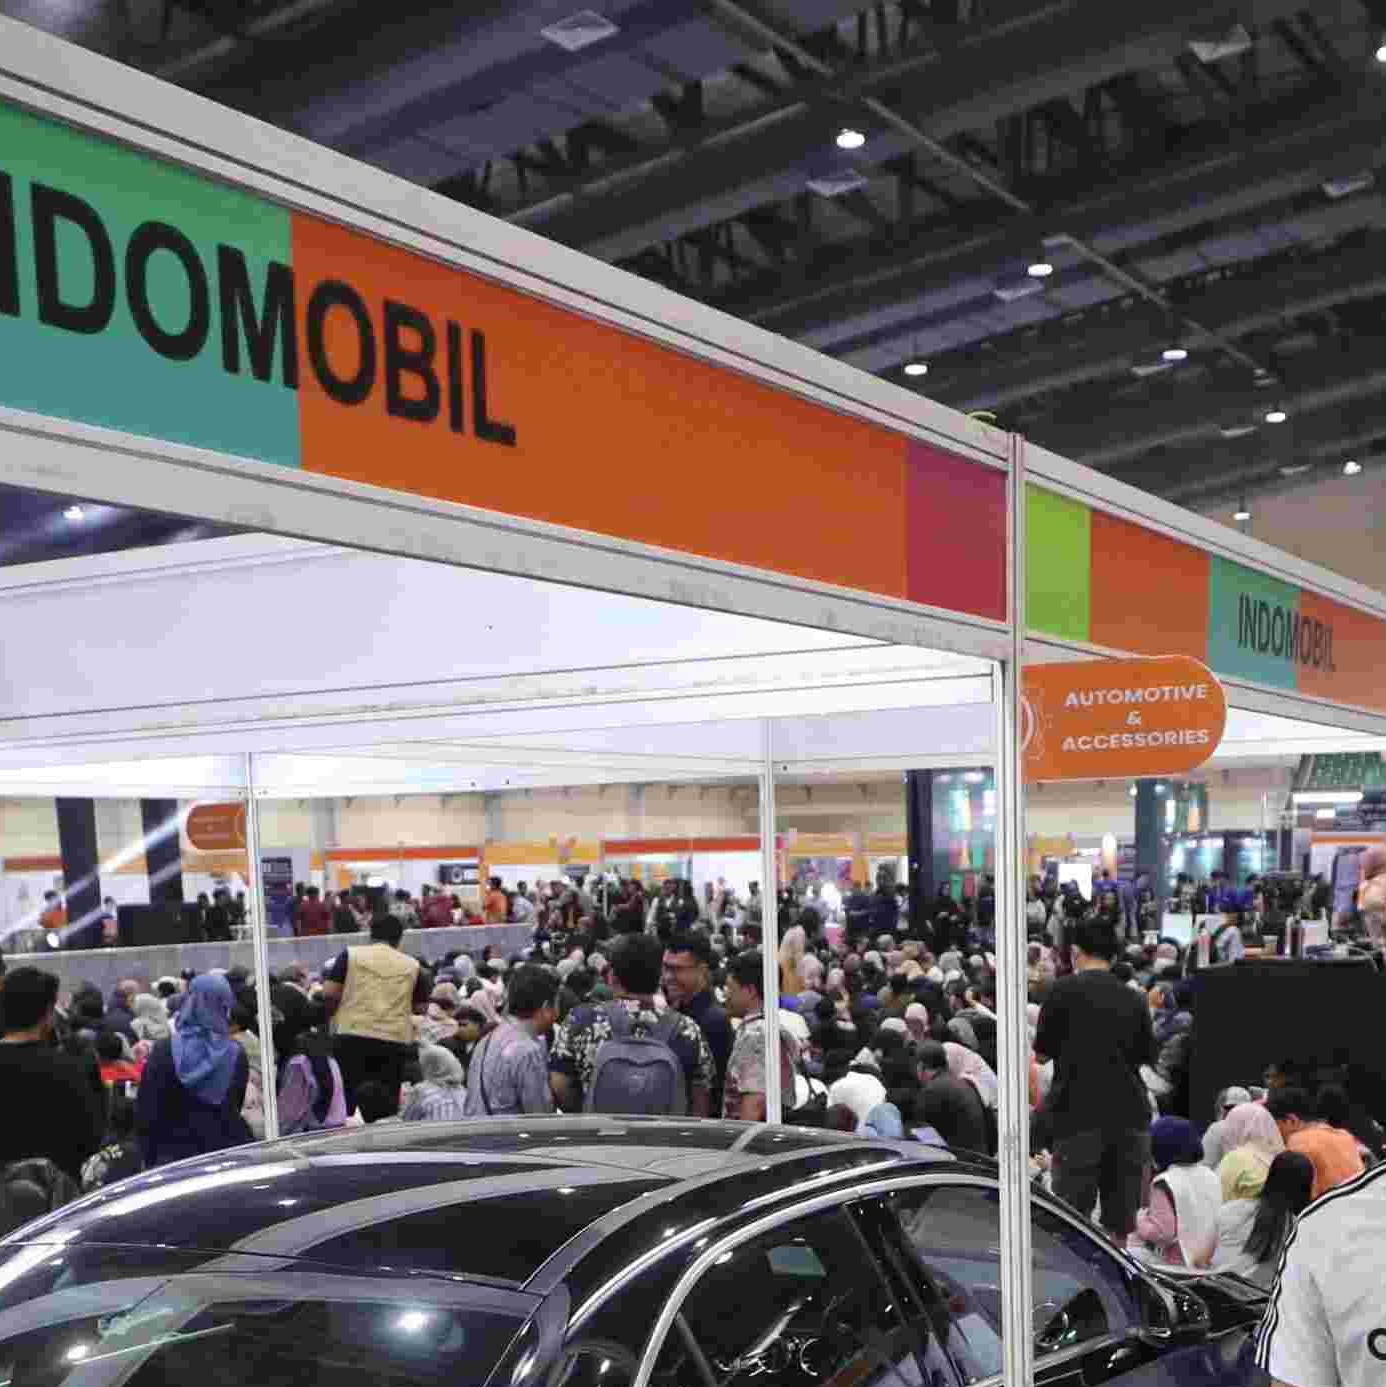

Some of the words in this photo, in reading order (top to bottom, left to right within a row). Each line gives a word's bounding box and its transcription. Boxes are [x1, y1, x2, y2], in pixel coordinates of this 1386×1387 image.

[1237, 592, 1336, 672] INDOMOBIL
[1064, 684, 1207, 707] AUTOMOTIVE
[1125, 710, 1141, 725] &
[1062, 729, 1210, 752] ACCESSORIES
